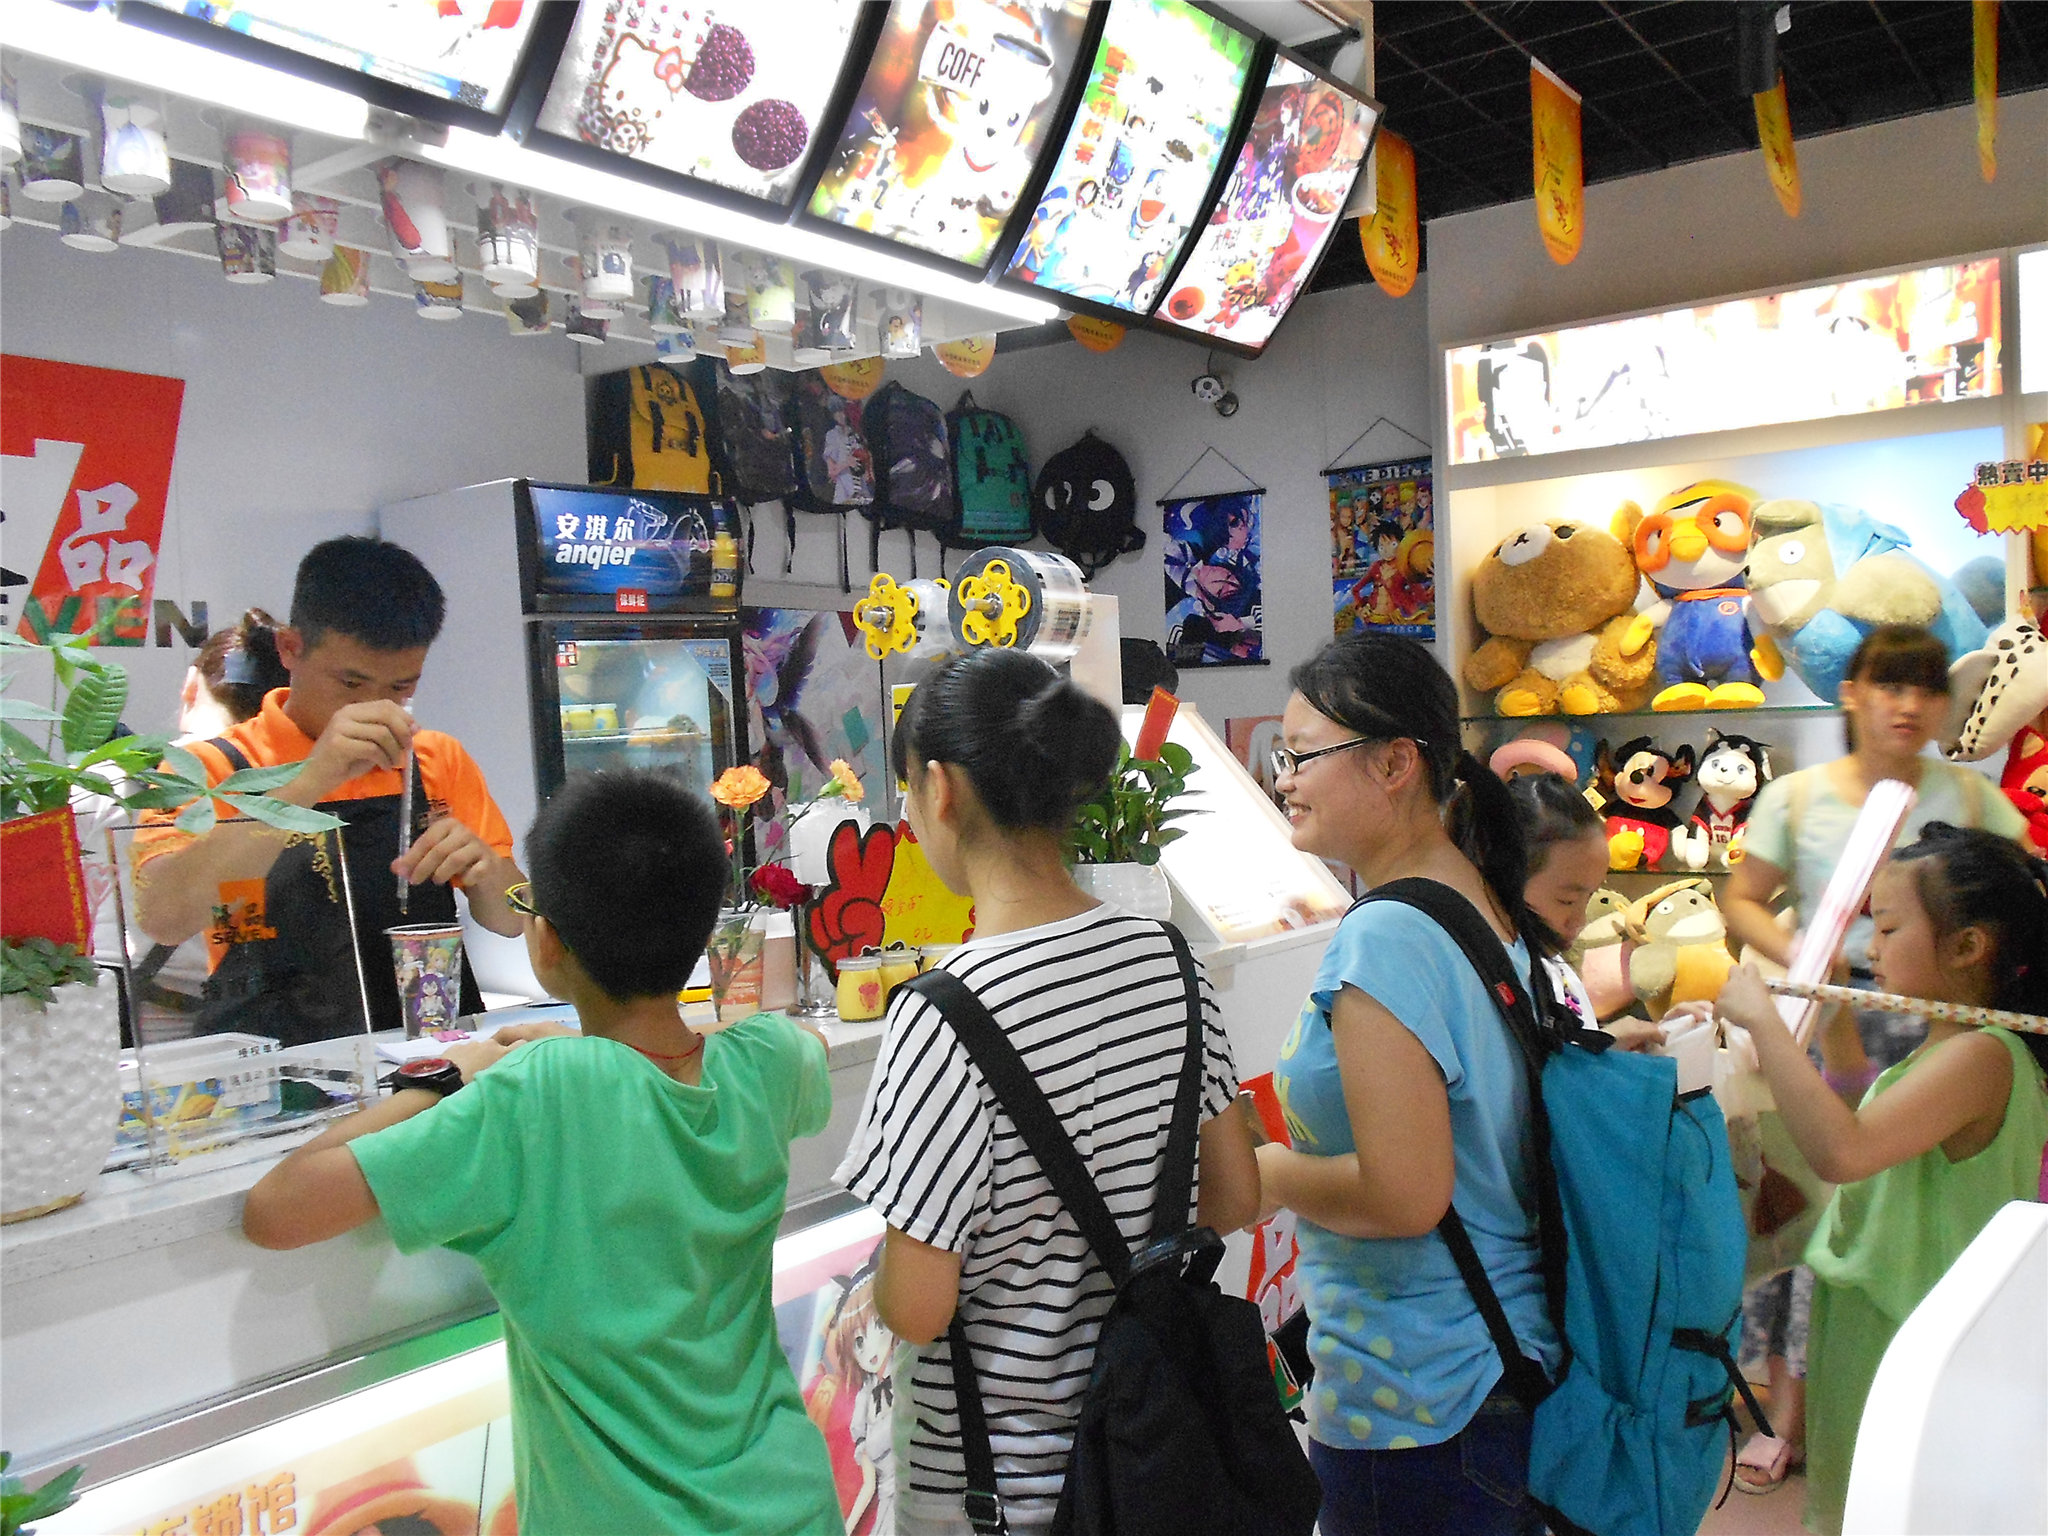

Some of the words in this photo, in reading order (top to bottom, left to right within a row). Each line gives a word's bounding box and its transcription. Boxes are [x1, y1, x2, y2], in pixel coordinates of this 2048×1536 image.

[937, 41, 986, 88] COFF
[58, 482, 154, 591] 品
[555, 512, 636, 542] 安淇尔
[555, 540, 635, 570] anqier
